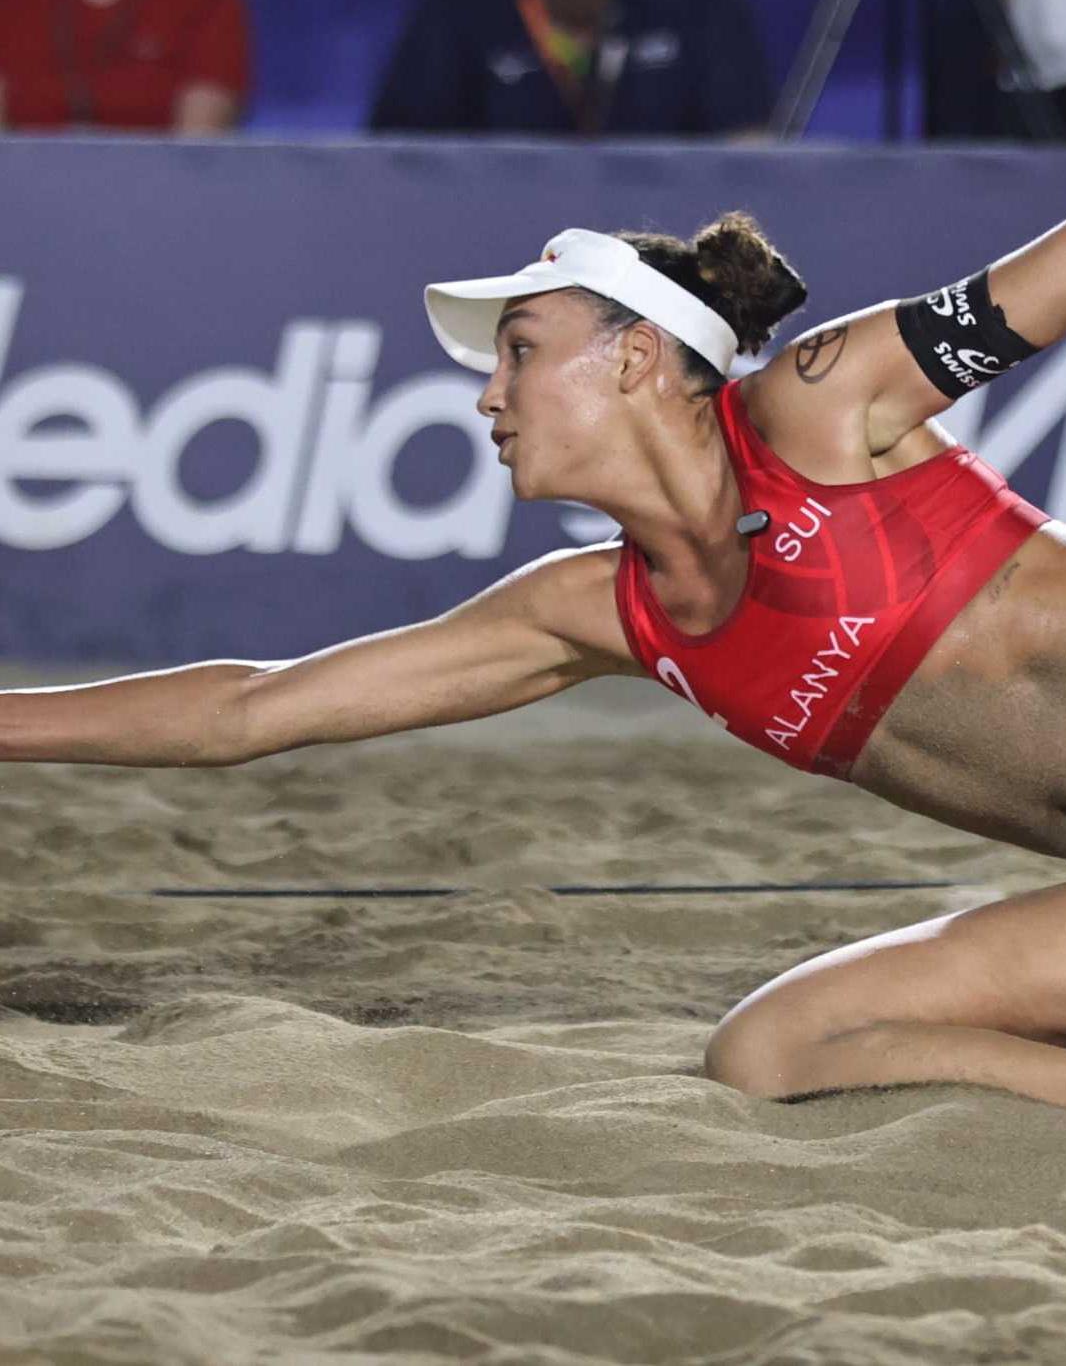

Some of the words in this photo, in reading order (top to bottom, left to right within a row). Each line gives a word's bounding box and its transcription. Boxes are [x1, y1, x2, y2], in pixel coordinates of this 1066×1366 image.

[0, 277, 512, 559] edia
[775, 497, 832, 562] SUI
[765, 614, 875, 750] ALANYA
